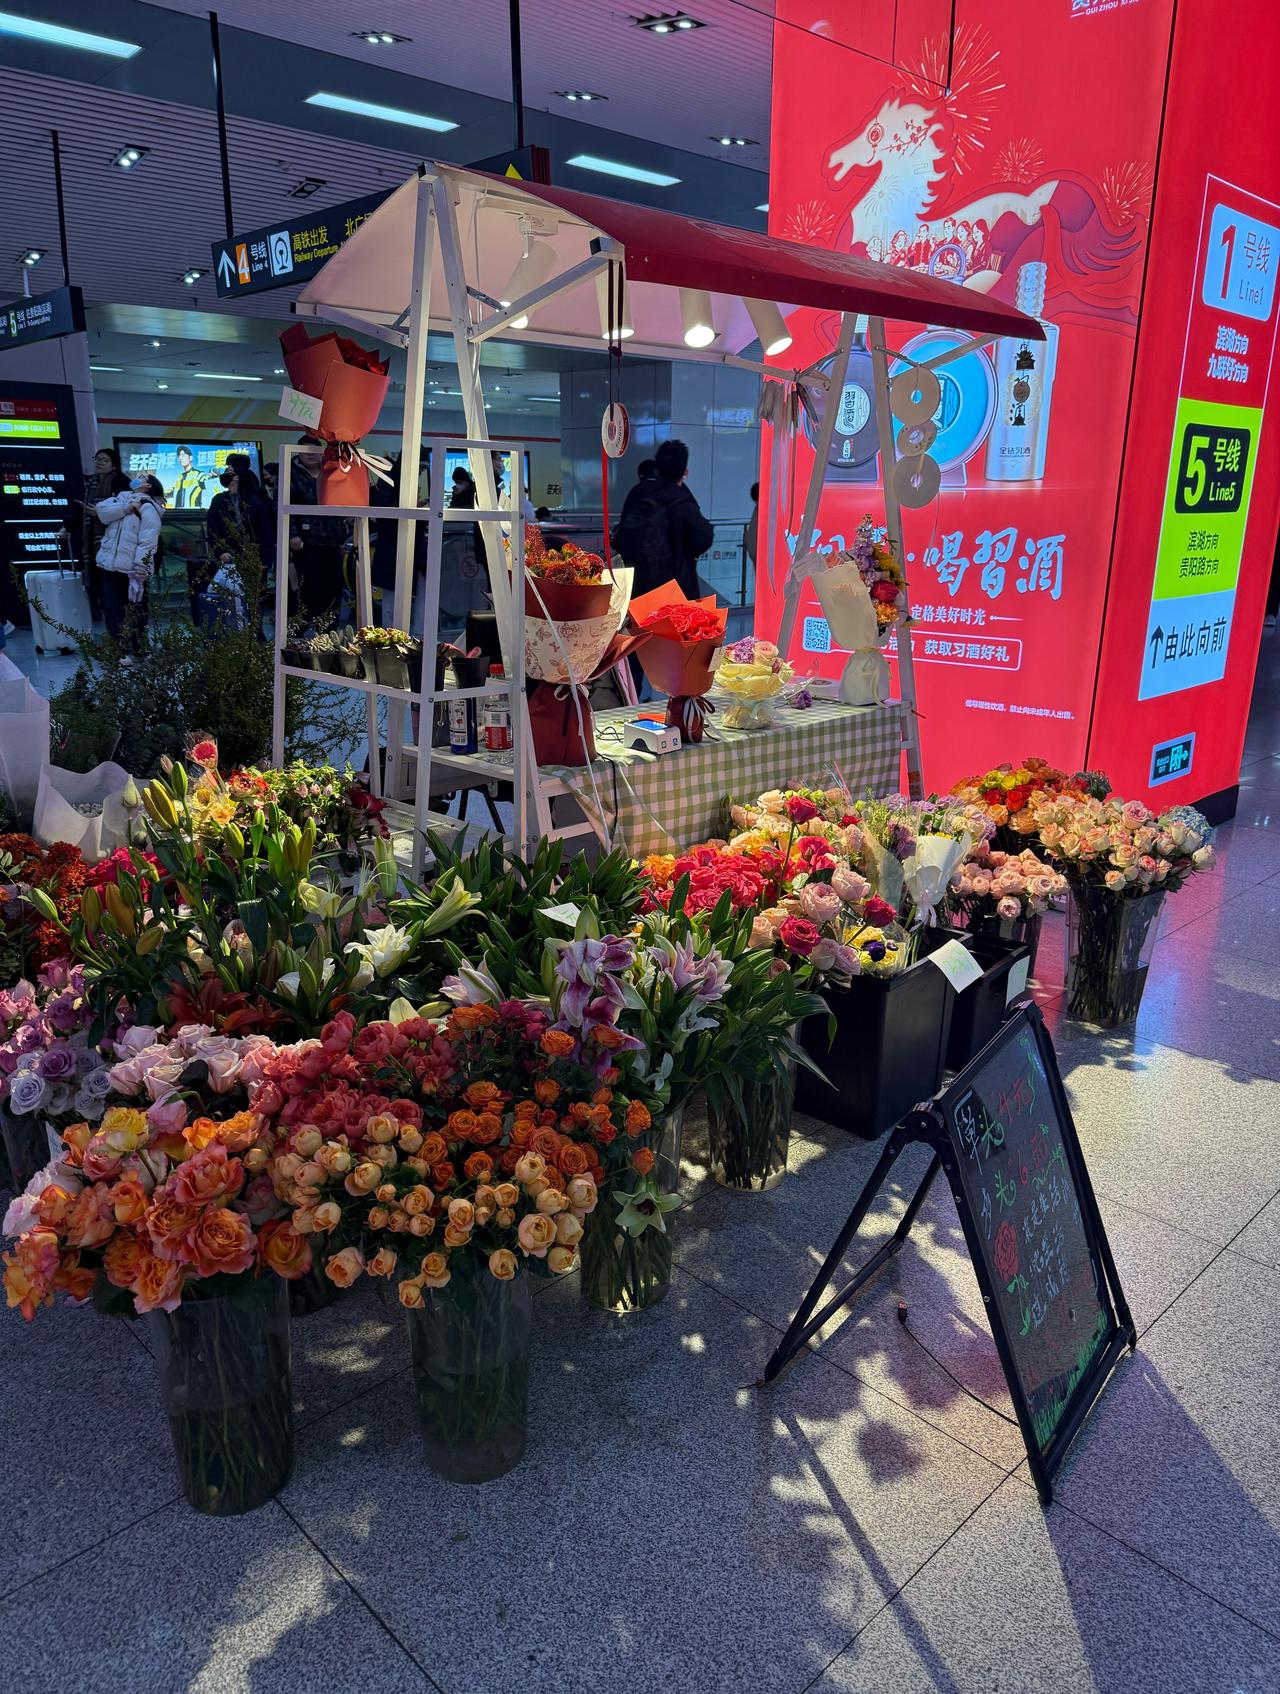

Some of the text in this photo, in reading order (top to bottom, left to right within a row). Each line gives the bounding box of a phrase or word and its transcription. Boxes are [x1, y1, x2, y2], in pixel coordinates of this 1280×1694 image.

[345, 212, 372, 236] 北广
[292, 227, 328, 251] 高铁出发
[239, 242, 267, 280] 4 号线
[294, 245, 339, 263] Railway Departure
[1220, 224, 1271, 299] 1 号线
[252, 261, 269, 272] Line 4
[1238, 278, 1265, 305] Line1
[10, 312, 17, 335] 5
[1215, 325, 1249, 355] 滨湖方向
[1206, 353, 1249, 383] 九联圩方向
[1184, 436, 1241, 507] 5 号线
[1209, 482, 1236, 501] Line5
[1187, 530, 1219, 551] 滨湖方向
[1179, 556, 1220, 578] 贵阳路方向
[911, 604, 986, 626] 定格美好时光
[924, 639, 1010, 662] 获取习酒好礼
[1163, 616, 1227, 663] 由此向前
